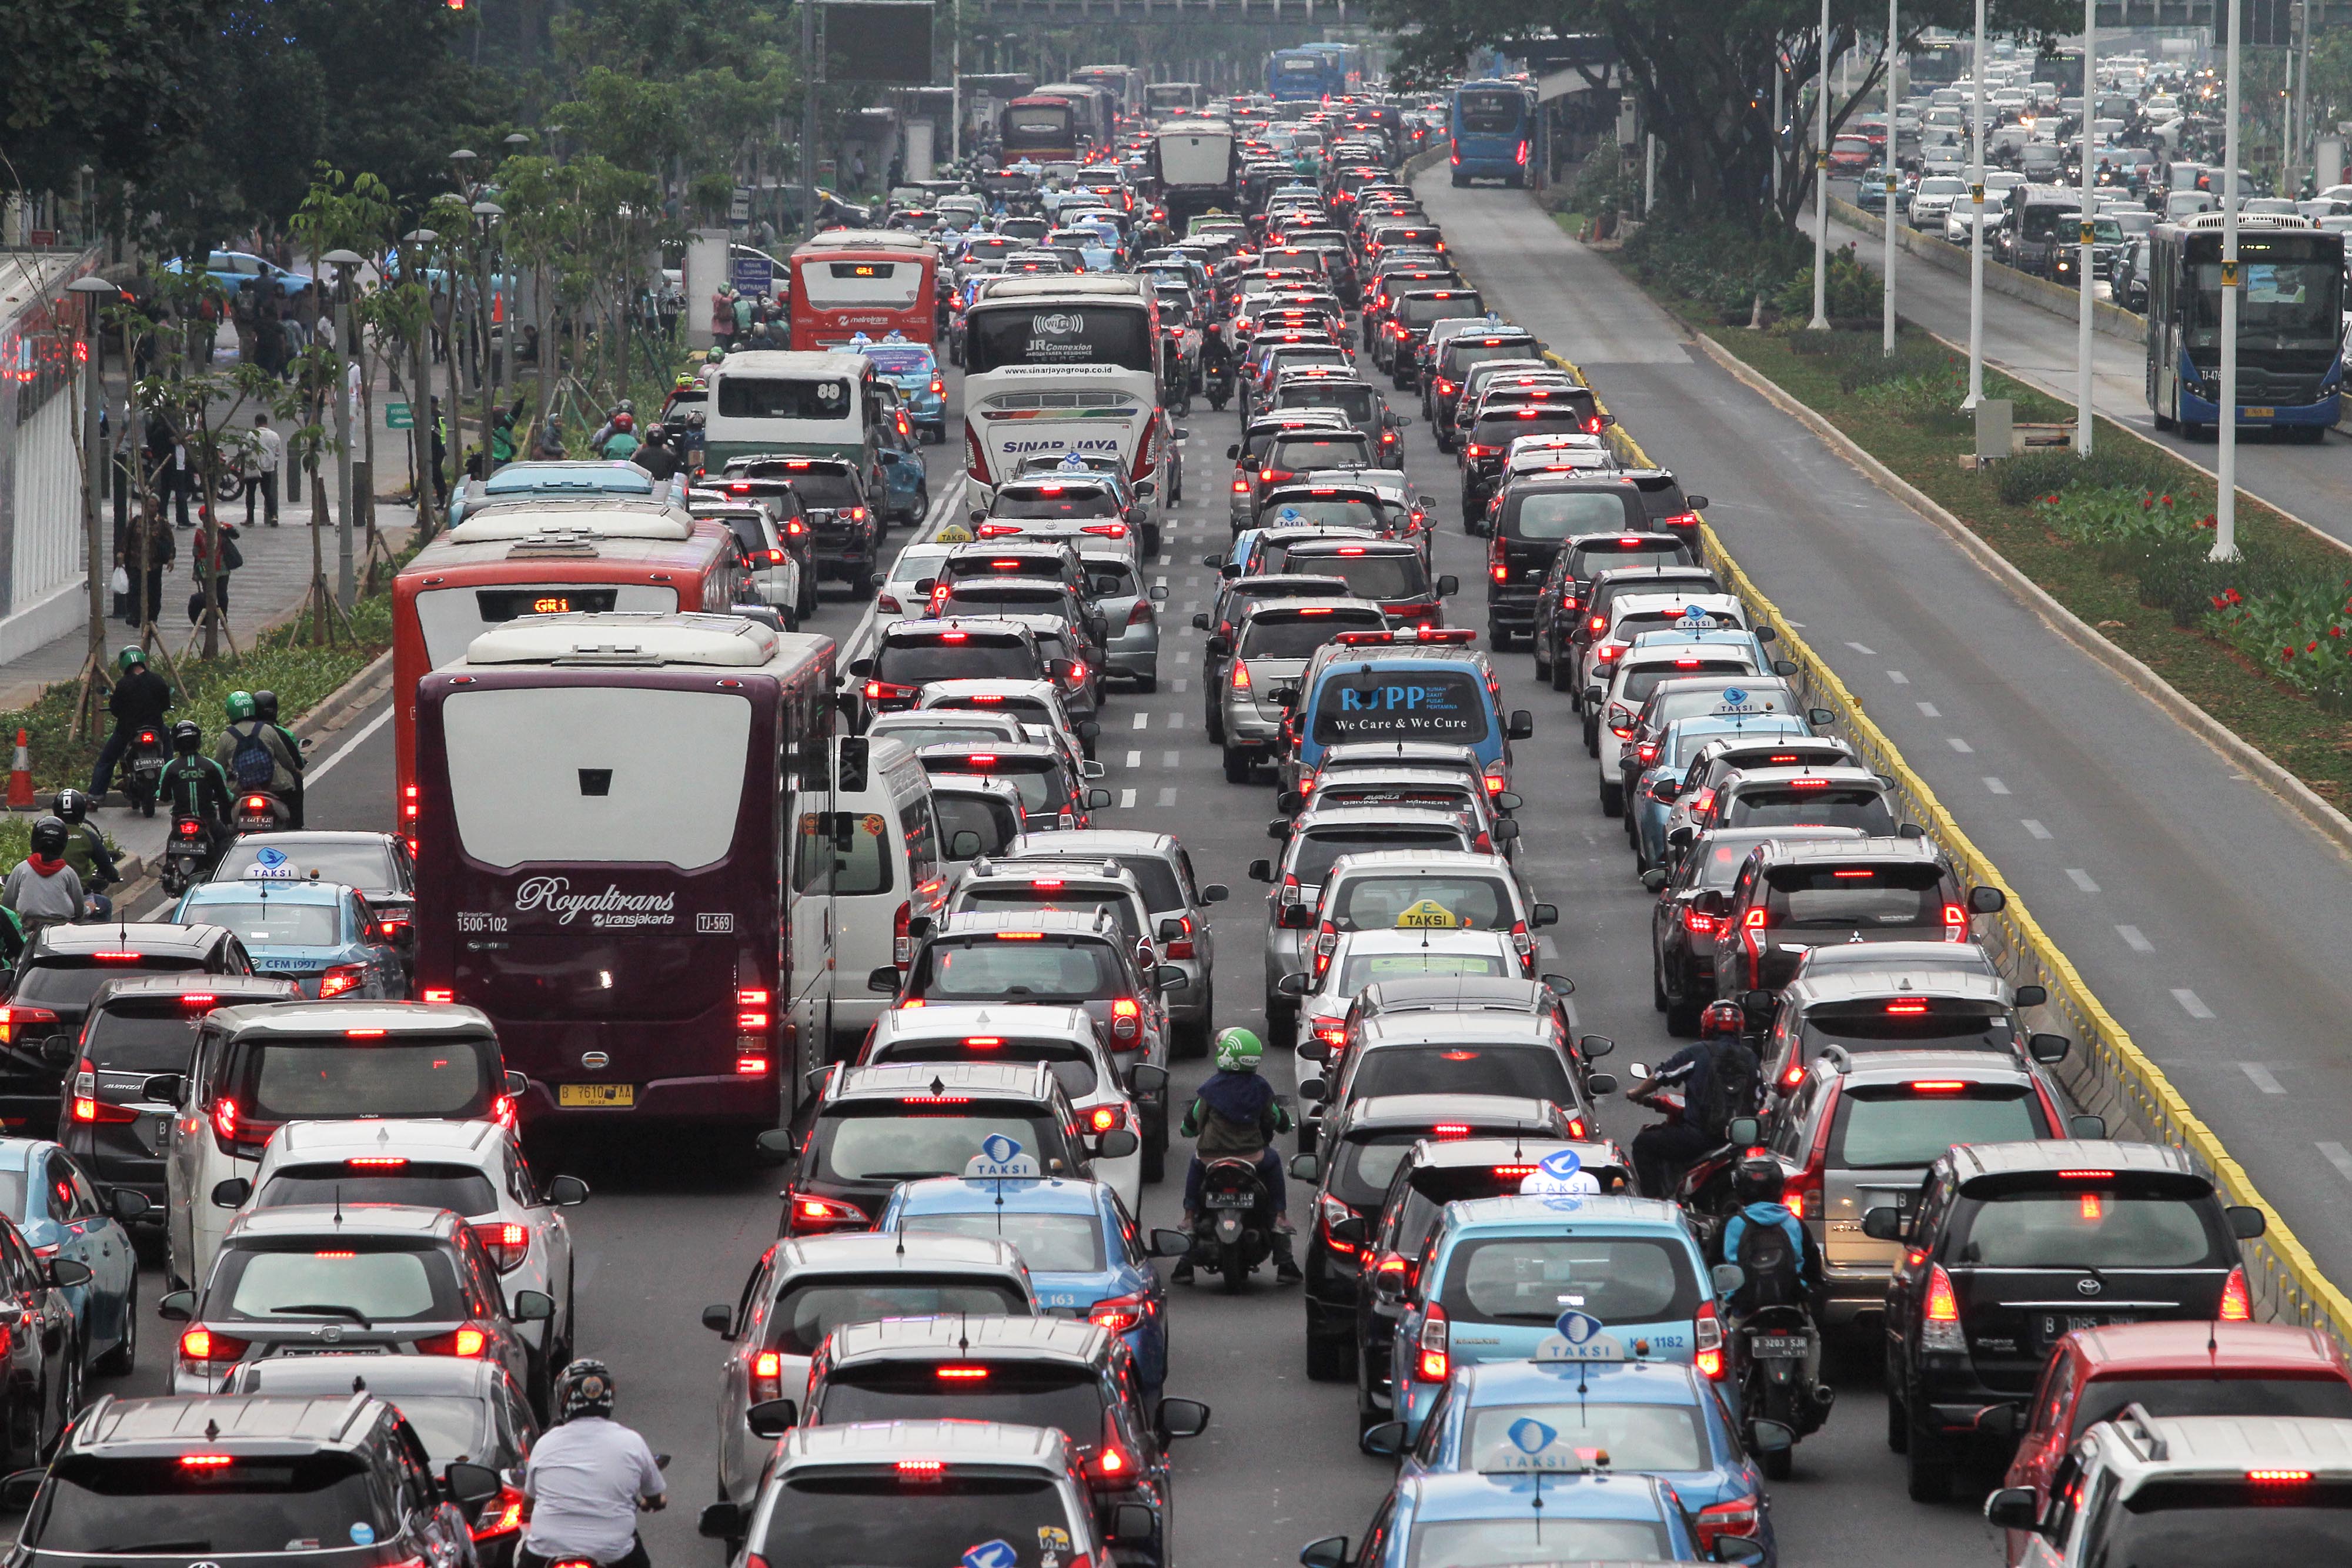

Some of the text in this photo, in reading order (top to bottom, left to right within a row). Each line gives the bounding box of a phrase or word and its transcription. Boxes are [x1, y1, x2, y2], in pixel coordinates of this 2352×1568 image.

[1025, 340, 1093, 352] JR Connexion
[1005, 366, 1112, 375] www.sinarjayagroup.co.id
[235, 697, 253, 707] Grab
[1335, 717, 1468, 731] We Care & We Cure
[178, 768, 206, 779] Grab
[515, 876, 675, 925] Royaltrans
[457, 917, 507, 932] 1500-102
[605, 913, 675, 927] transjakarta
[700, 916, 730, 930] TJ-569
[1407, 915, 1446, 925] TAKSI
[266, 959, 318, 970] CFM 1997
[562, 1085, 632, 1098] B 7610 TAA
[159, 1122, 166, 1135] B
[977, 1165, 1027, 1174] TAKSI
[1535, 1182, 1588, 1193] TAKSI
[1899, 1192, 1907, 1208] B
[1050, 1294, 1075, 1305] 163
[2045, 1317, 2054, 1333] B
[1654, 1336, 1684, 1348] 1182
[1551, 1346, 1610, 1357] TAKSI
[1502, 1455, 1567, 1468] TAKSI
